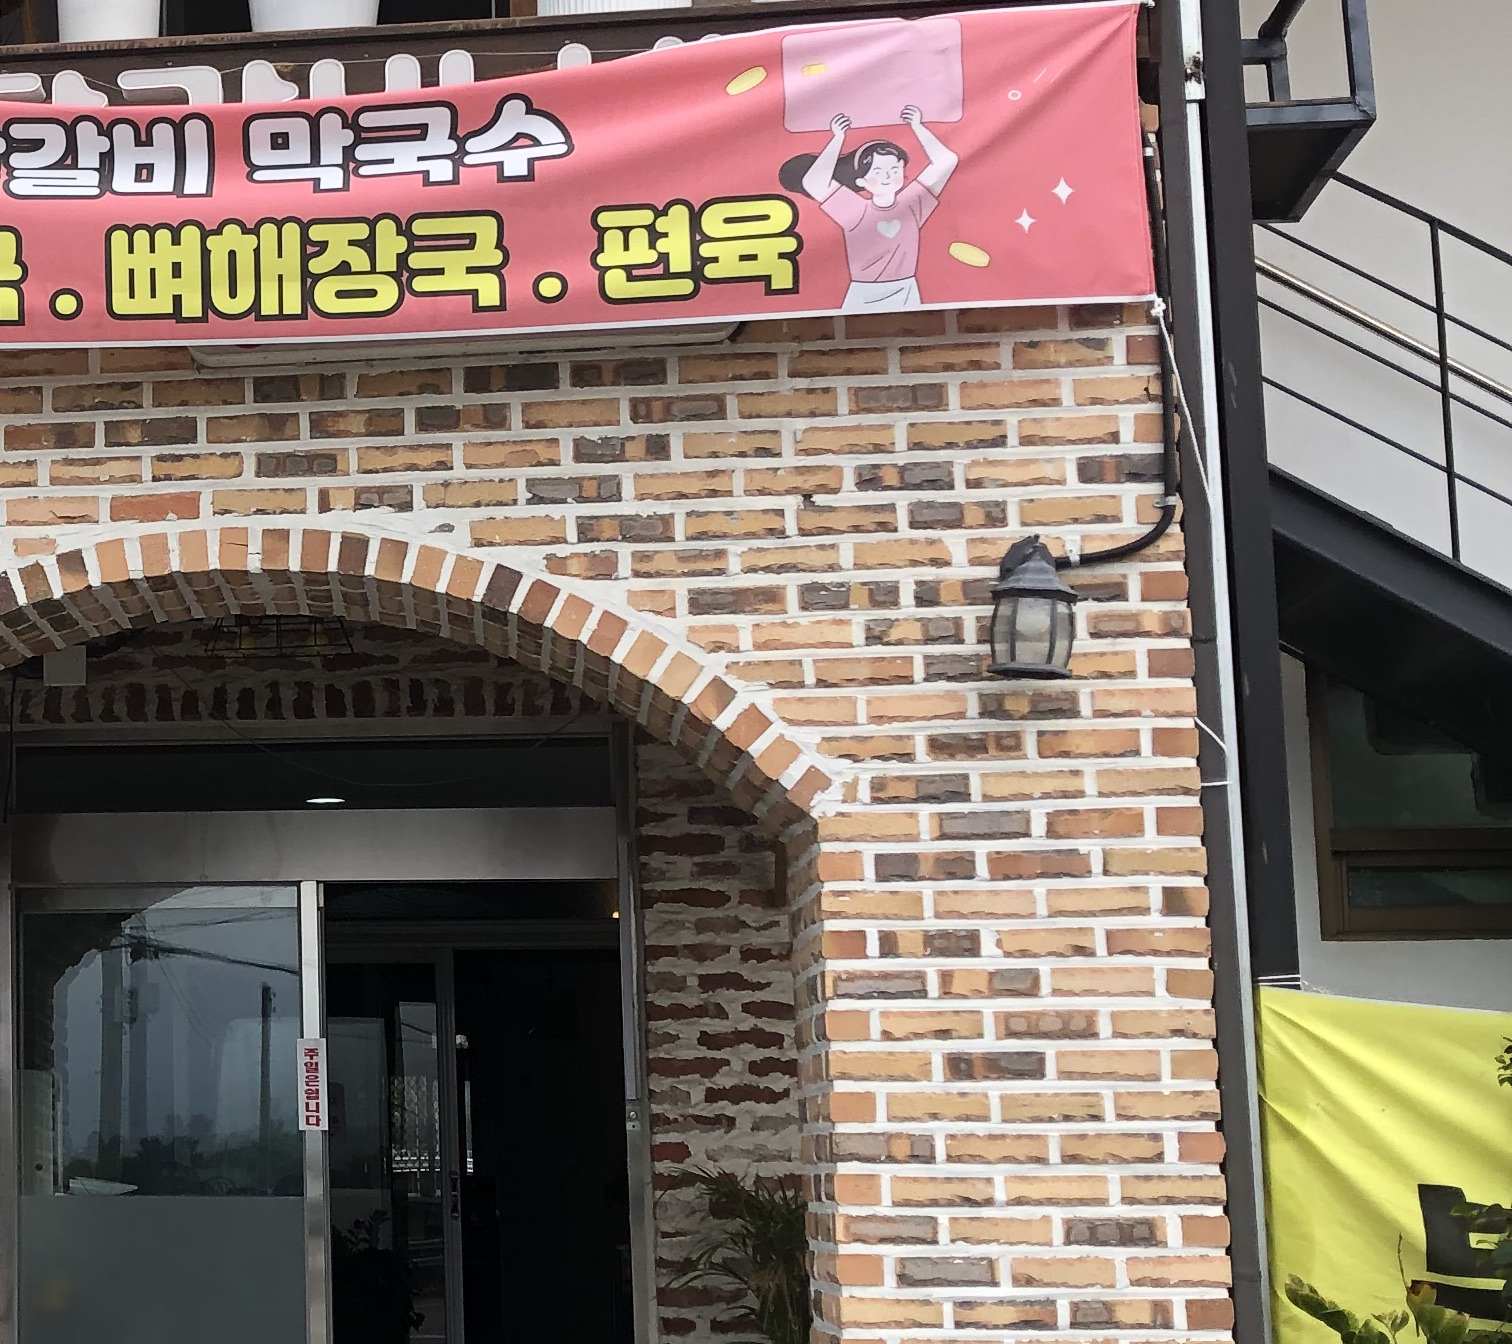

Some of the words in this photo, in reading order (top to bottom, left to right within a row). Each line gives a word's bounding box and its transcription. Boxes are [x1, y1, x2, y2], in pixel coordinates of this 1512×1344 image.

[242, 93, 574, 191] 막국수
[104, 209, 509, 324] 뼈해장국
[591, 194, 803, 304] 편육
